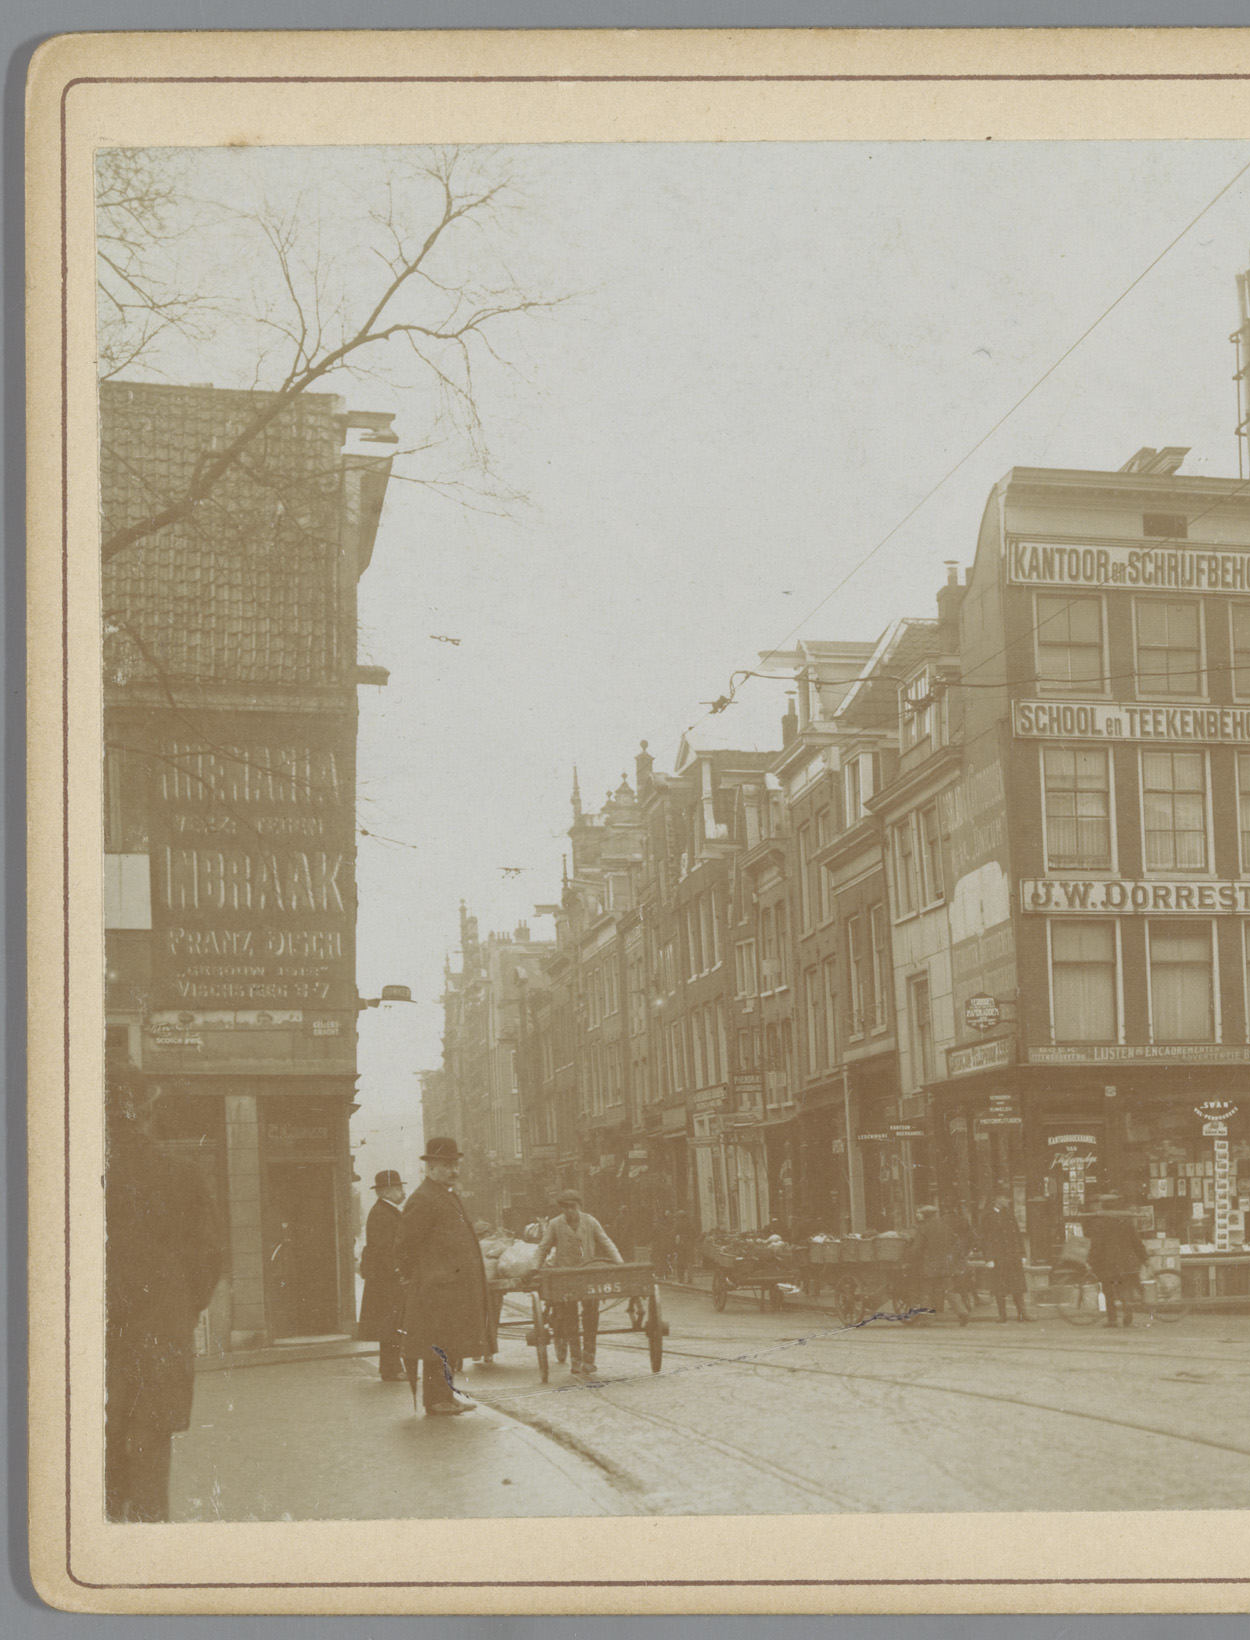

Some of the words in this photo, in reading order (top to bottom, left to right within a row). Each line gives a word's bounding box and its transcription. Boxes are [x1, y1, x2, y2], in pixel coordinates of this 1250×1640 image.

[1013, 545, 1109, 583] KANTOOR
[1111, 562, 1127, 584] en
[1019, 703, 1102, 735] SCHOOL
[1105, 715, 1122, 736] en
[1094, 1046, 1135, 1061] LIJSTEN
